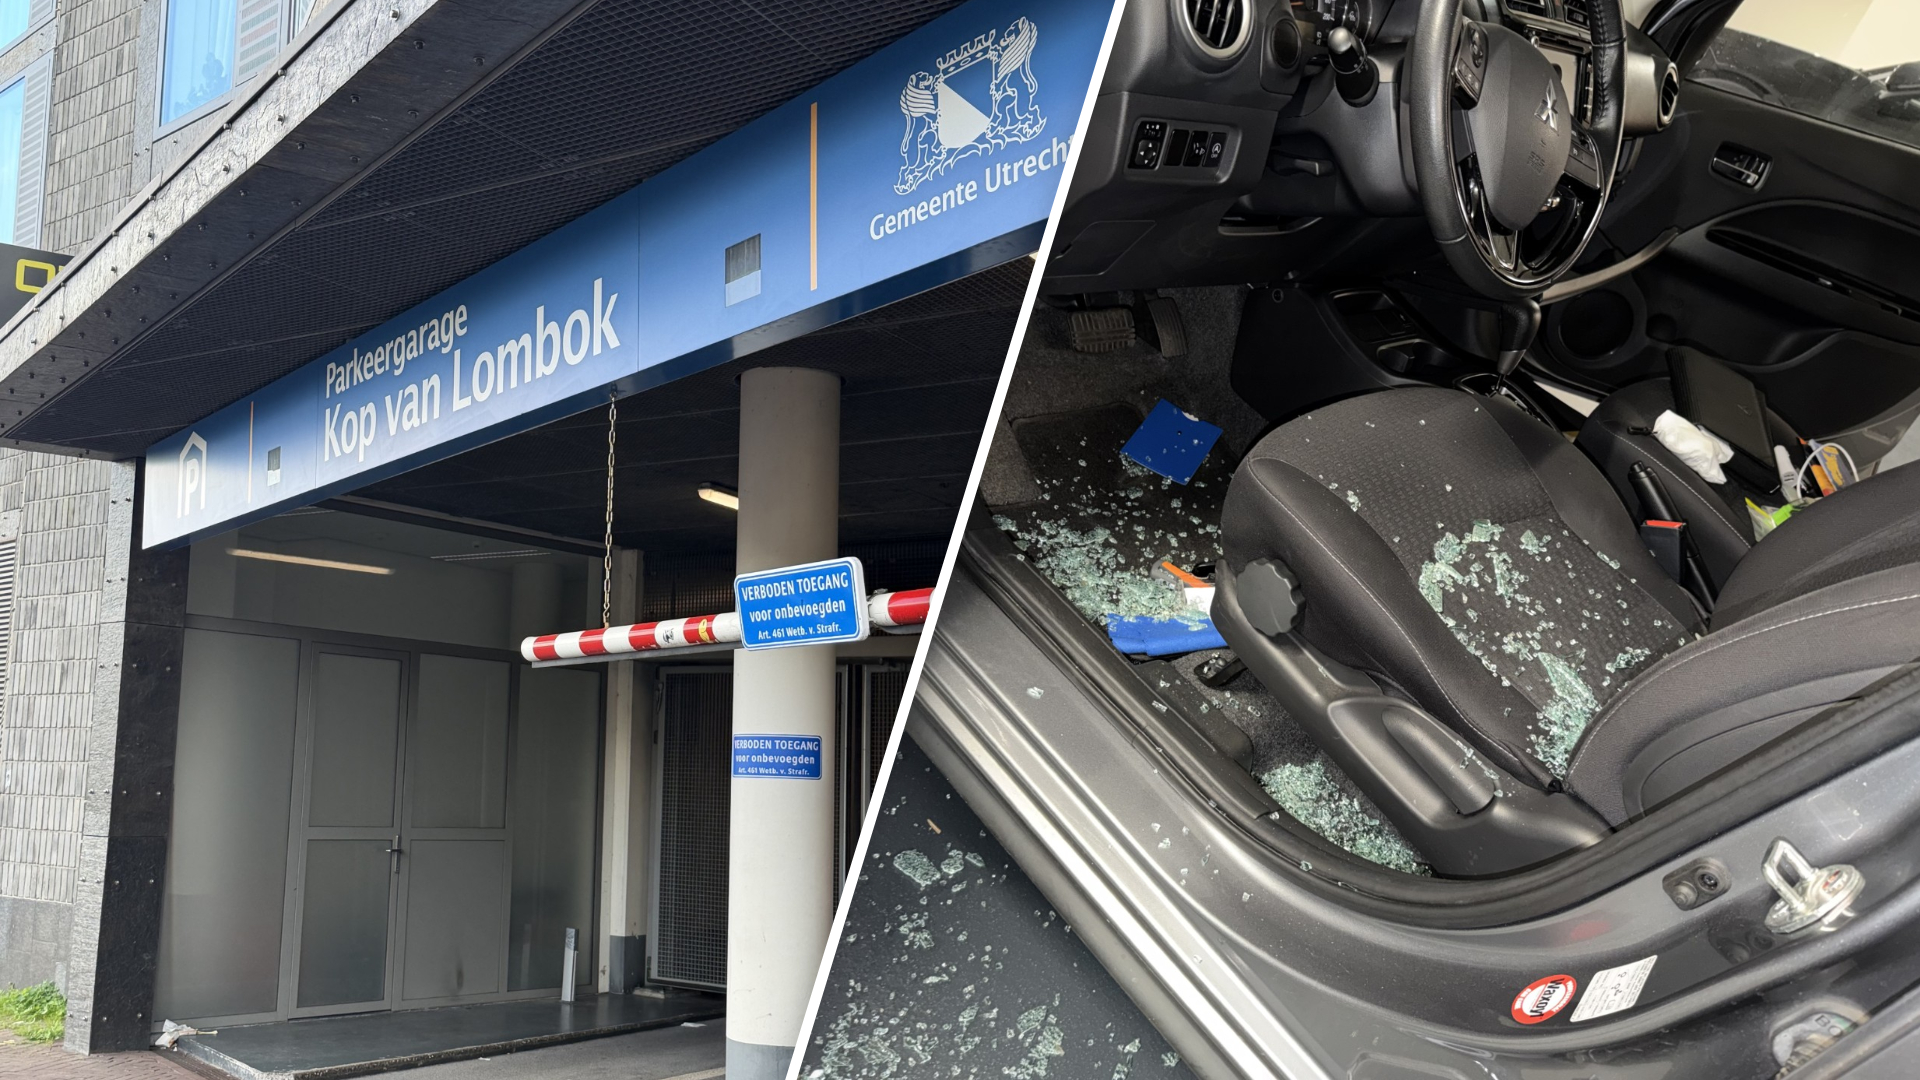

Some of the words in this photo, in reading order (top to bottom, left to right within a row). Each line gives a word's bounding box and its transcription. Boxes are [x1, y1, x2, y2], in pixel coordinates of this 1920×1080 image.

[869, 180, 978, 240] Gemeente
[325, 304, 468, 399] Parkeergarage
[324, 402, 377, 463] Kop
[384, 373, 441, 437] van
[452, 277, 621, 412] Lombok
[185, 458, 200, 517] P
[741, 580, 795, 602] VERBODEN
[796, 571, 849, 594] TOEGANG
[749, 608, 772, 623] voor
[774, 597, 847, 620] onbevoegden
[758, 630, 771, 640] Art.
[772, 628, 785, 638] 461
[786, 625, 808, 638] Wetb.
[809, 627, 815, 635] v.
[816, 621, 842, 634] Strafr.
[735, 754, 750, 762] voor
[751, 753, 815, 766] onbevoegden
[774, 740, 819, 751] TOEGANG
[747, 766, 758, 774] 461
[758, 766, 779, 774] Wetb.
[787, 767, 810, 776] Strafr.
[1529, 977, 1566, 1019] Waxoyl
